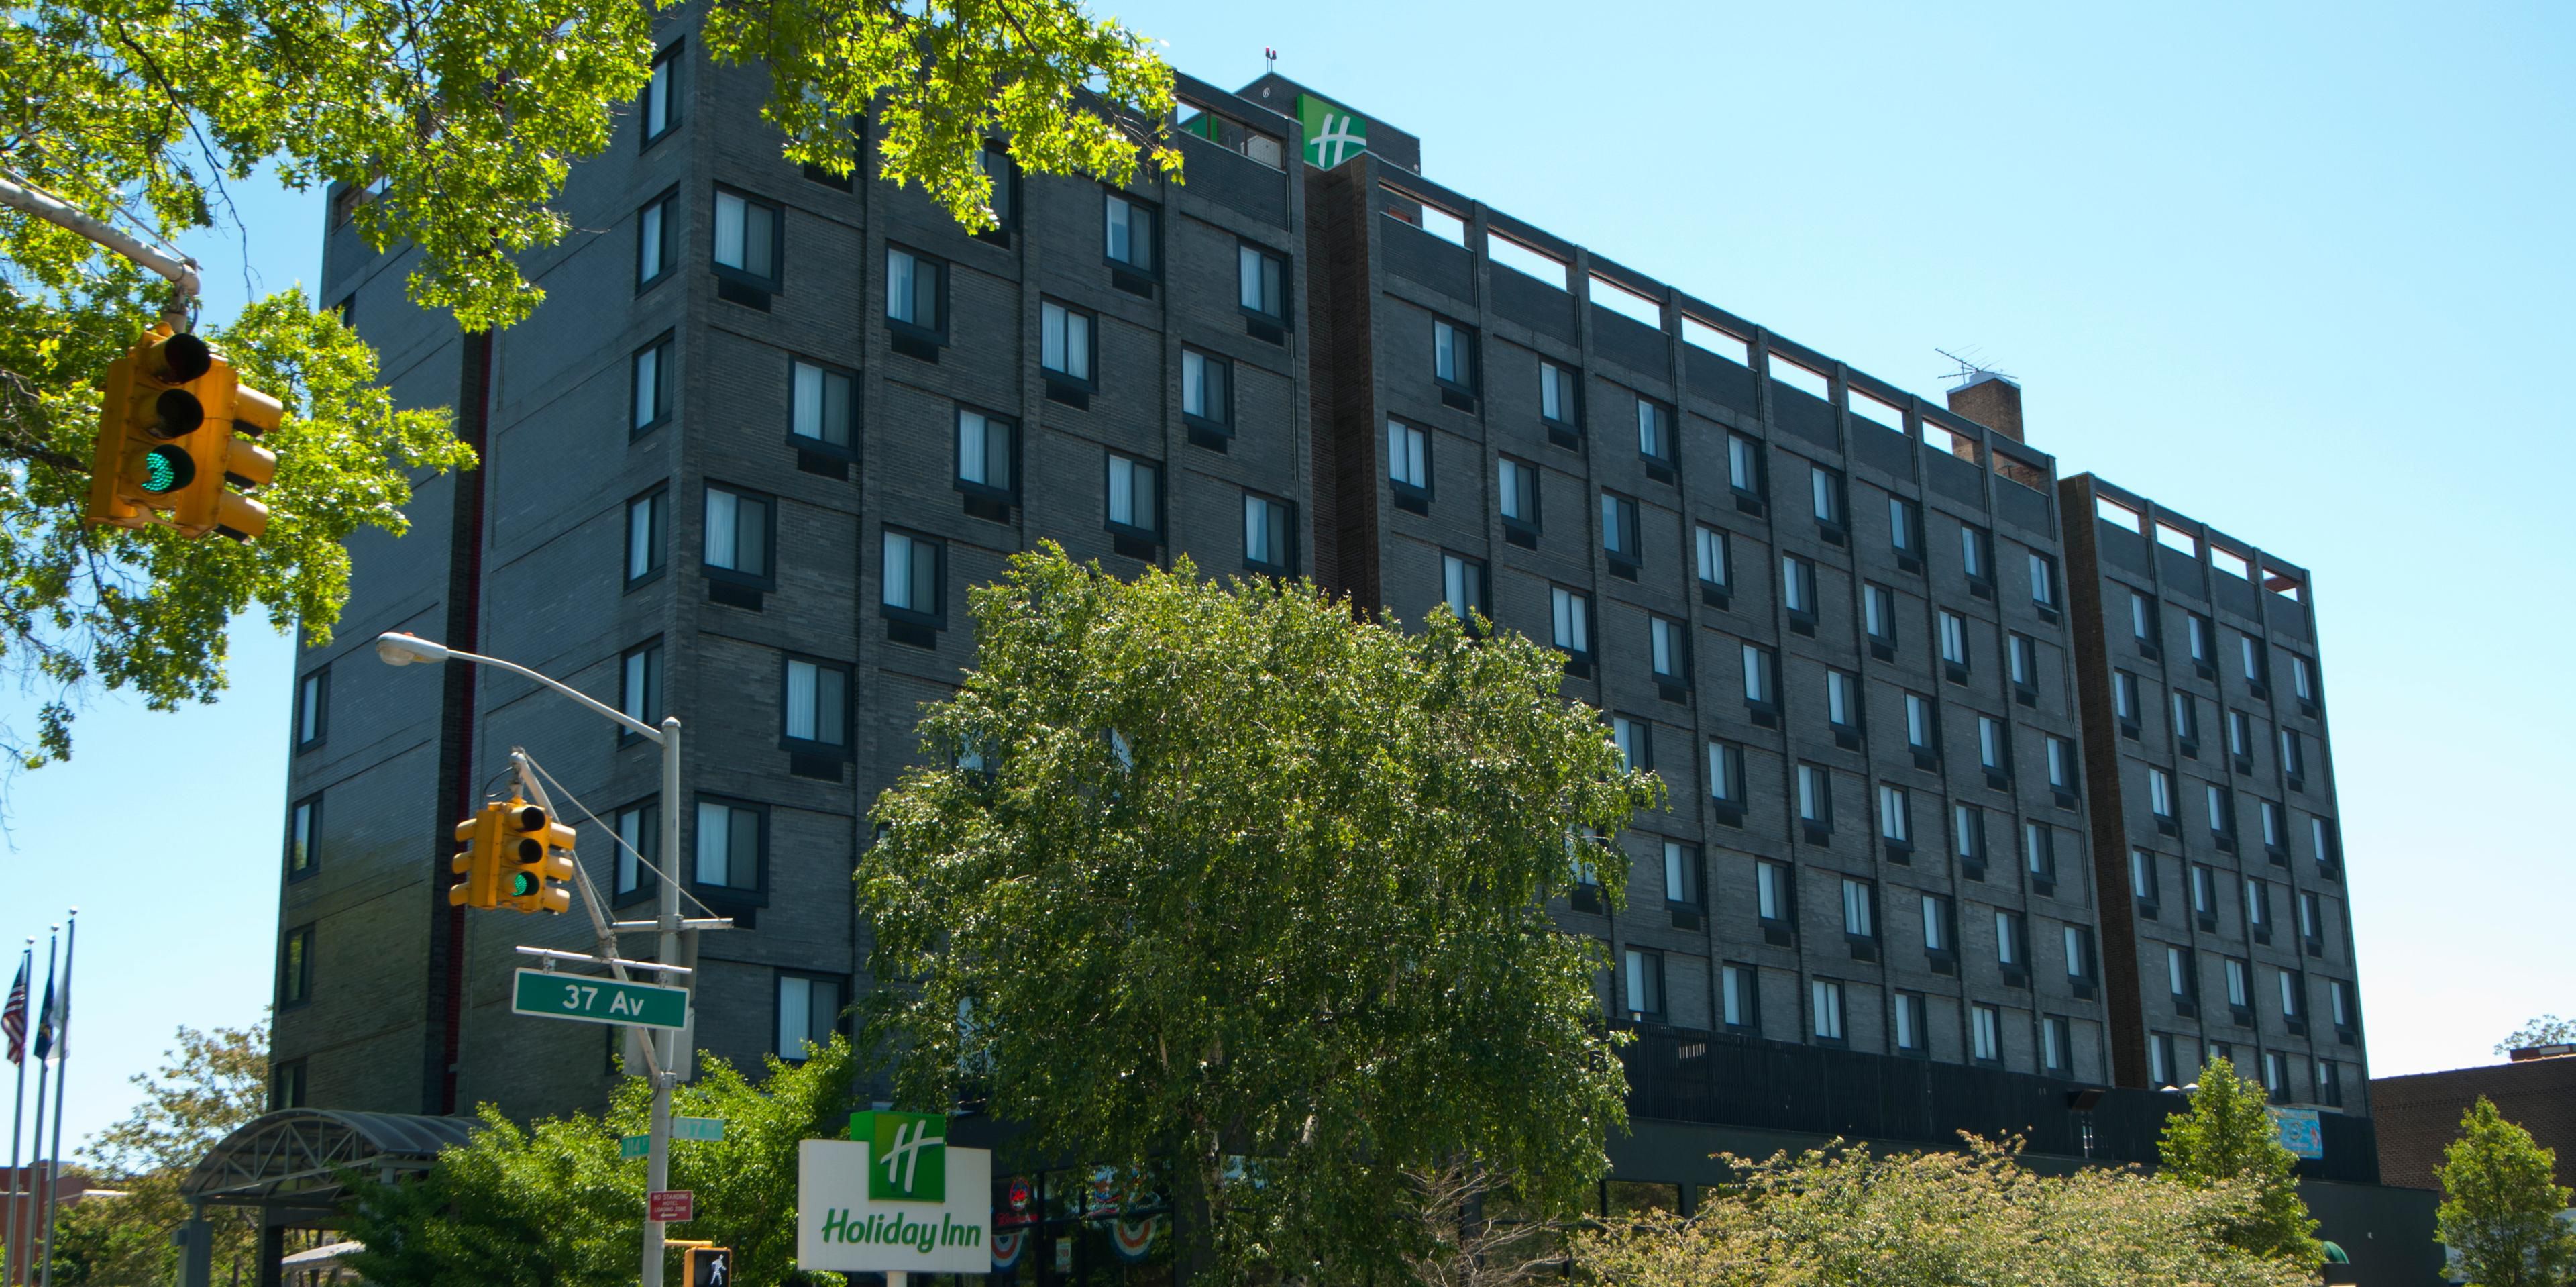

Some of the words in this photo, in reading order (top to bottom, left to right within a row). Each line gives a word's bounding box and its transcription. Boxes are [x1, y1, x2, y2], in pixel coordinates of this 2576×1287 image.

[562, 984, 598, 1011] 37
[609, 990, 645, 1017] Av
[821, 1208, 938, 1253] Holiday
[941, 1213, 981, 1247] Inn
